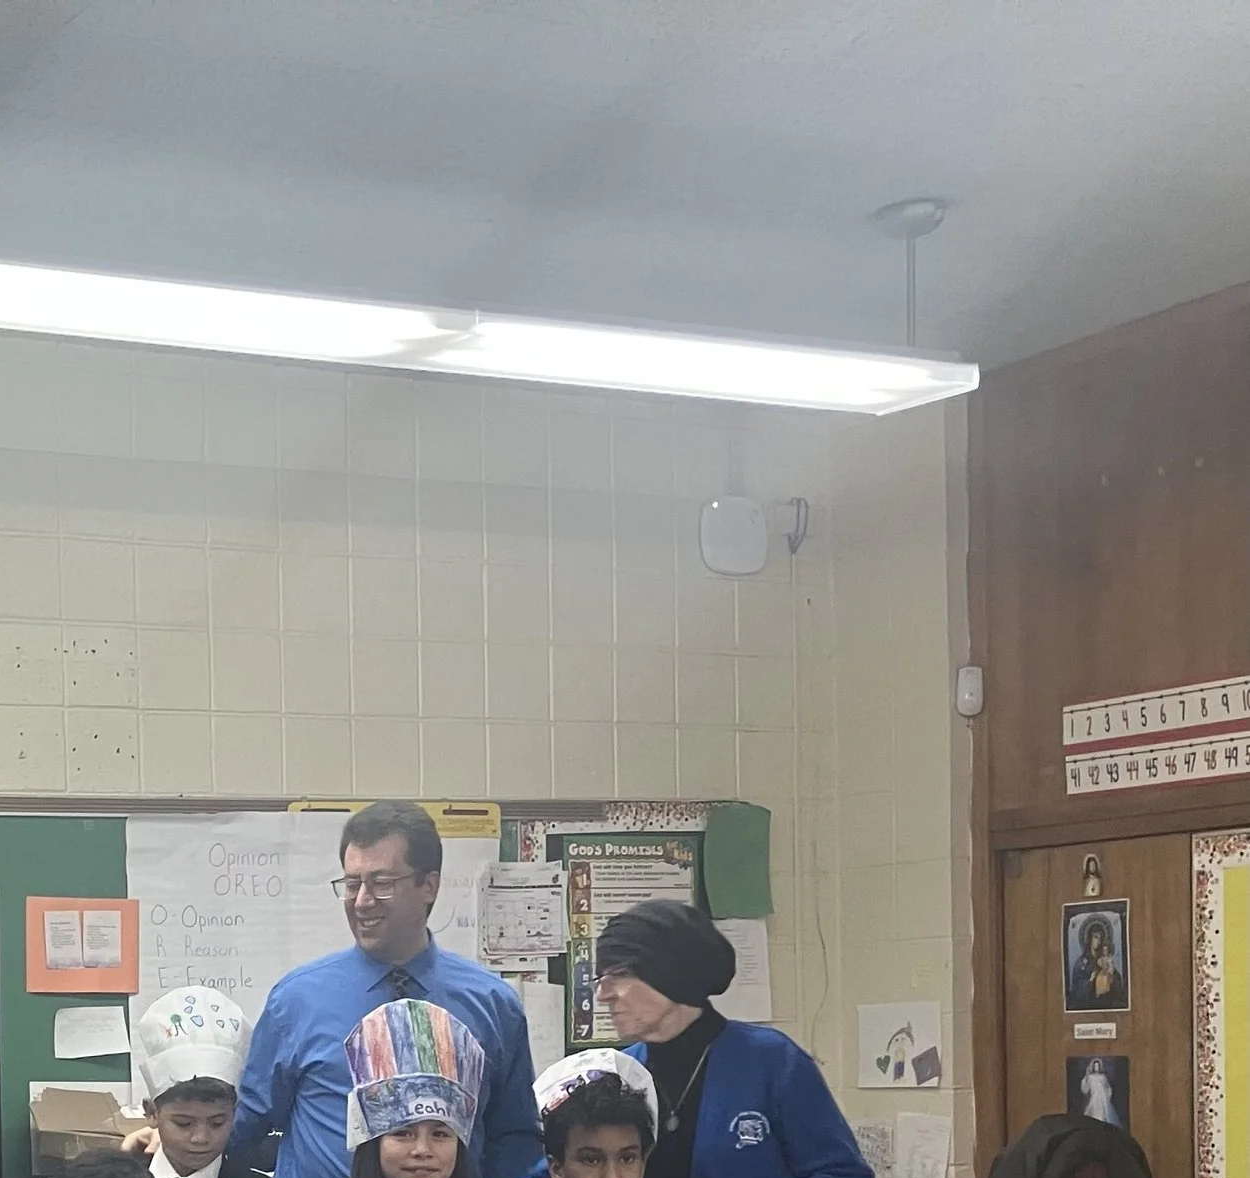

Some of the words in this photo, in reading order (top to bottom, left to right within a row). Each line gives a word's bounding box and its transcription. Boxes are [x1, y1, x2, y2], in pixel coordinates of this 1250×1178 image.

[1070, 719, 1074, 738] 1
[1086, 716, 1093, 735] 2
[1104, 713, 1111, 732] 3
[1122, 710, 1129, 730] 4
[1140, 706, 1147, 727] 5
[1159, 704, 1166, 724] 6
[1179, 700, 1185, 721] 7
[1200, 697, 1208, 718] 8
[1221, 693, 1230, 714] 9
[1070, 767, 1081, 788] 41
[1088, 765, 1100, 785] 42
[1106, 763, 1119, 783] 43
[1126, 760, 1139, 780] 44
[1145, 757, 1158, 778] 45
[1165, 754, 1177, 775] 46
[1183, 752, 1197, 773] 47
[1204, 749, 1217, 770] 48
[1225, 746, 1238, 768] 49
[208, 843, 281, 875] Opinion
[580, 899, 589, 911] 2
[181, 905, 245, 933] Opinion
[580, 924, 589, 936] 3
[184, 933, 239, 958] Reason
[186, 965, 253, 996] Example
[581, 999, 591, 1011] 6
[580, 1025, 589, 1036] 7
[403, 1102, 448, 1118] Leah
